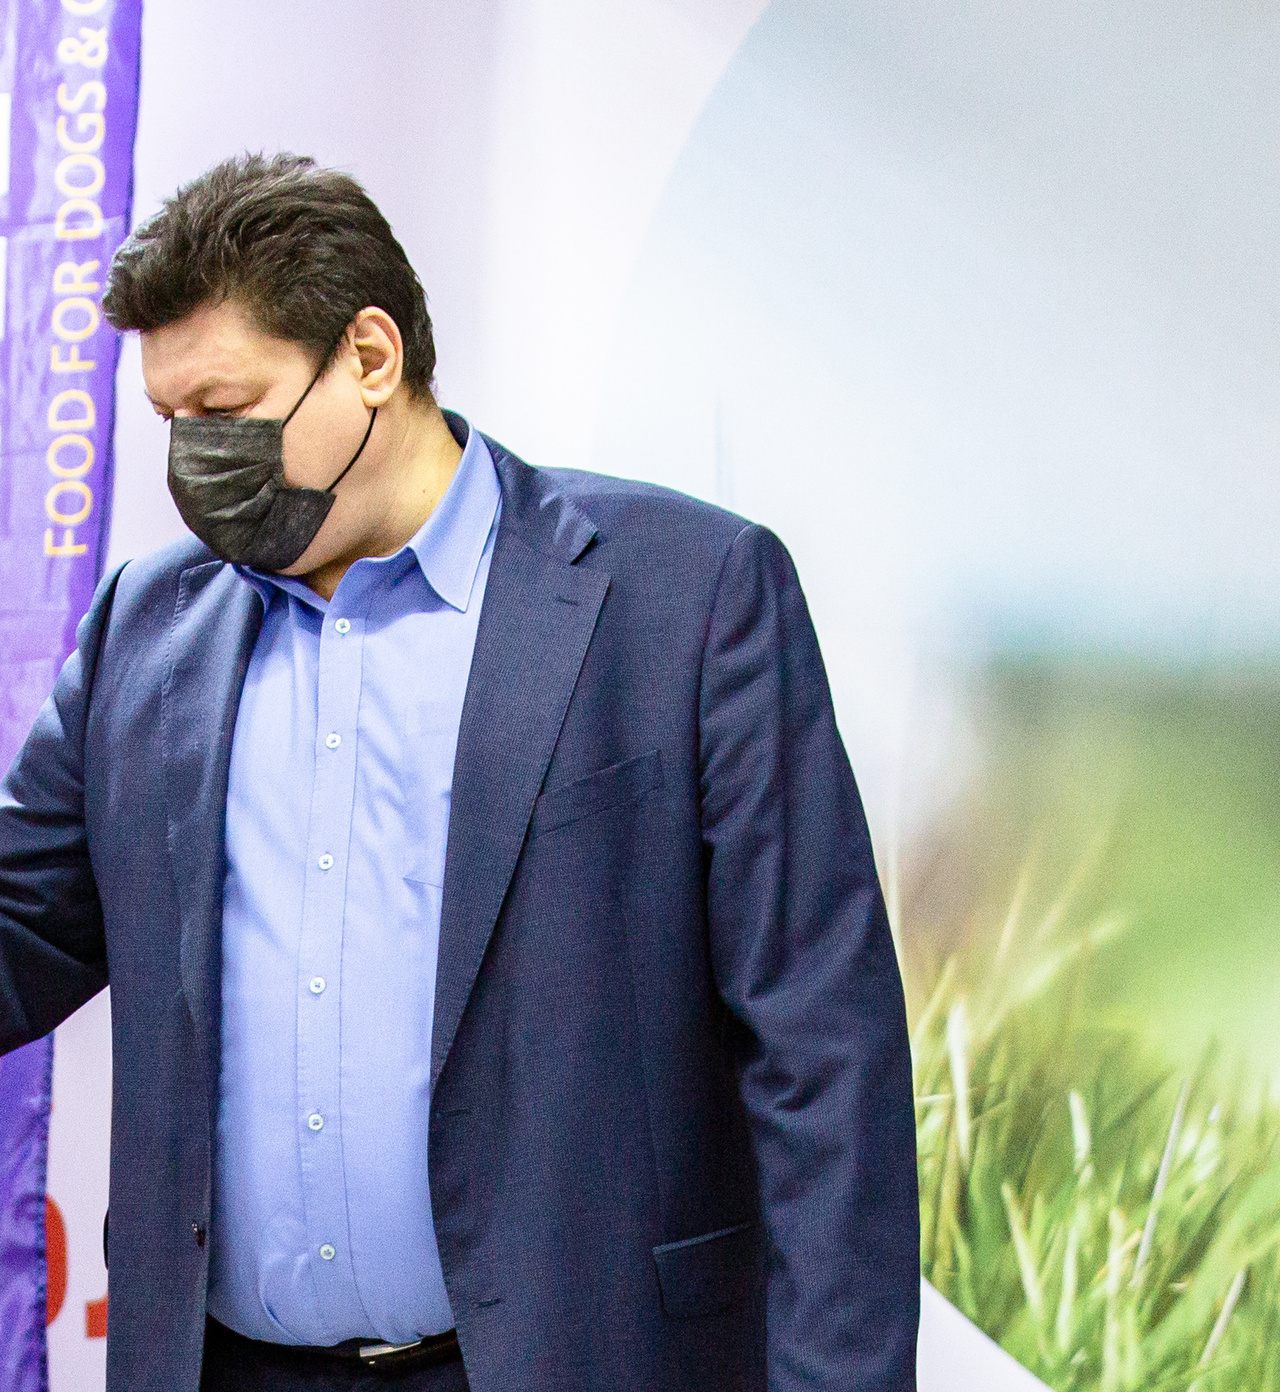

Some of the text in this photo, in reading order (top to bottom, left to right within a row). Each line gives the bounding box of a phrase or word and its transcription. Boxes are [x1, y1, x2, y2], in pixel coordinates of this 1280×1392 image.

[58, 27, 109, 68] &
[56, 81, 106, 239] DOGS
[52, 258, 100, 373] FOR
[44, 400, 95, 556] FOOD
